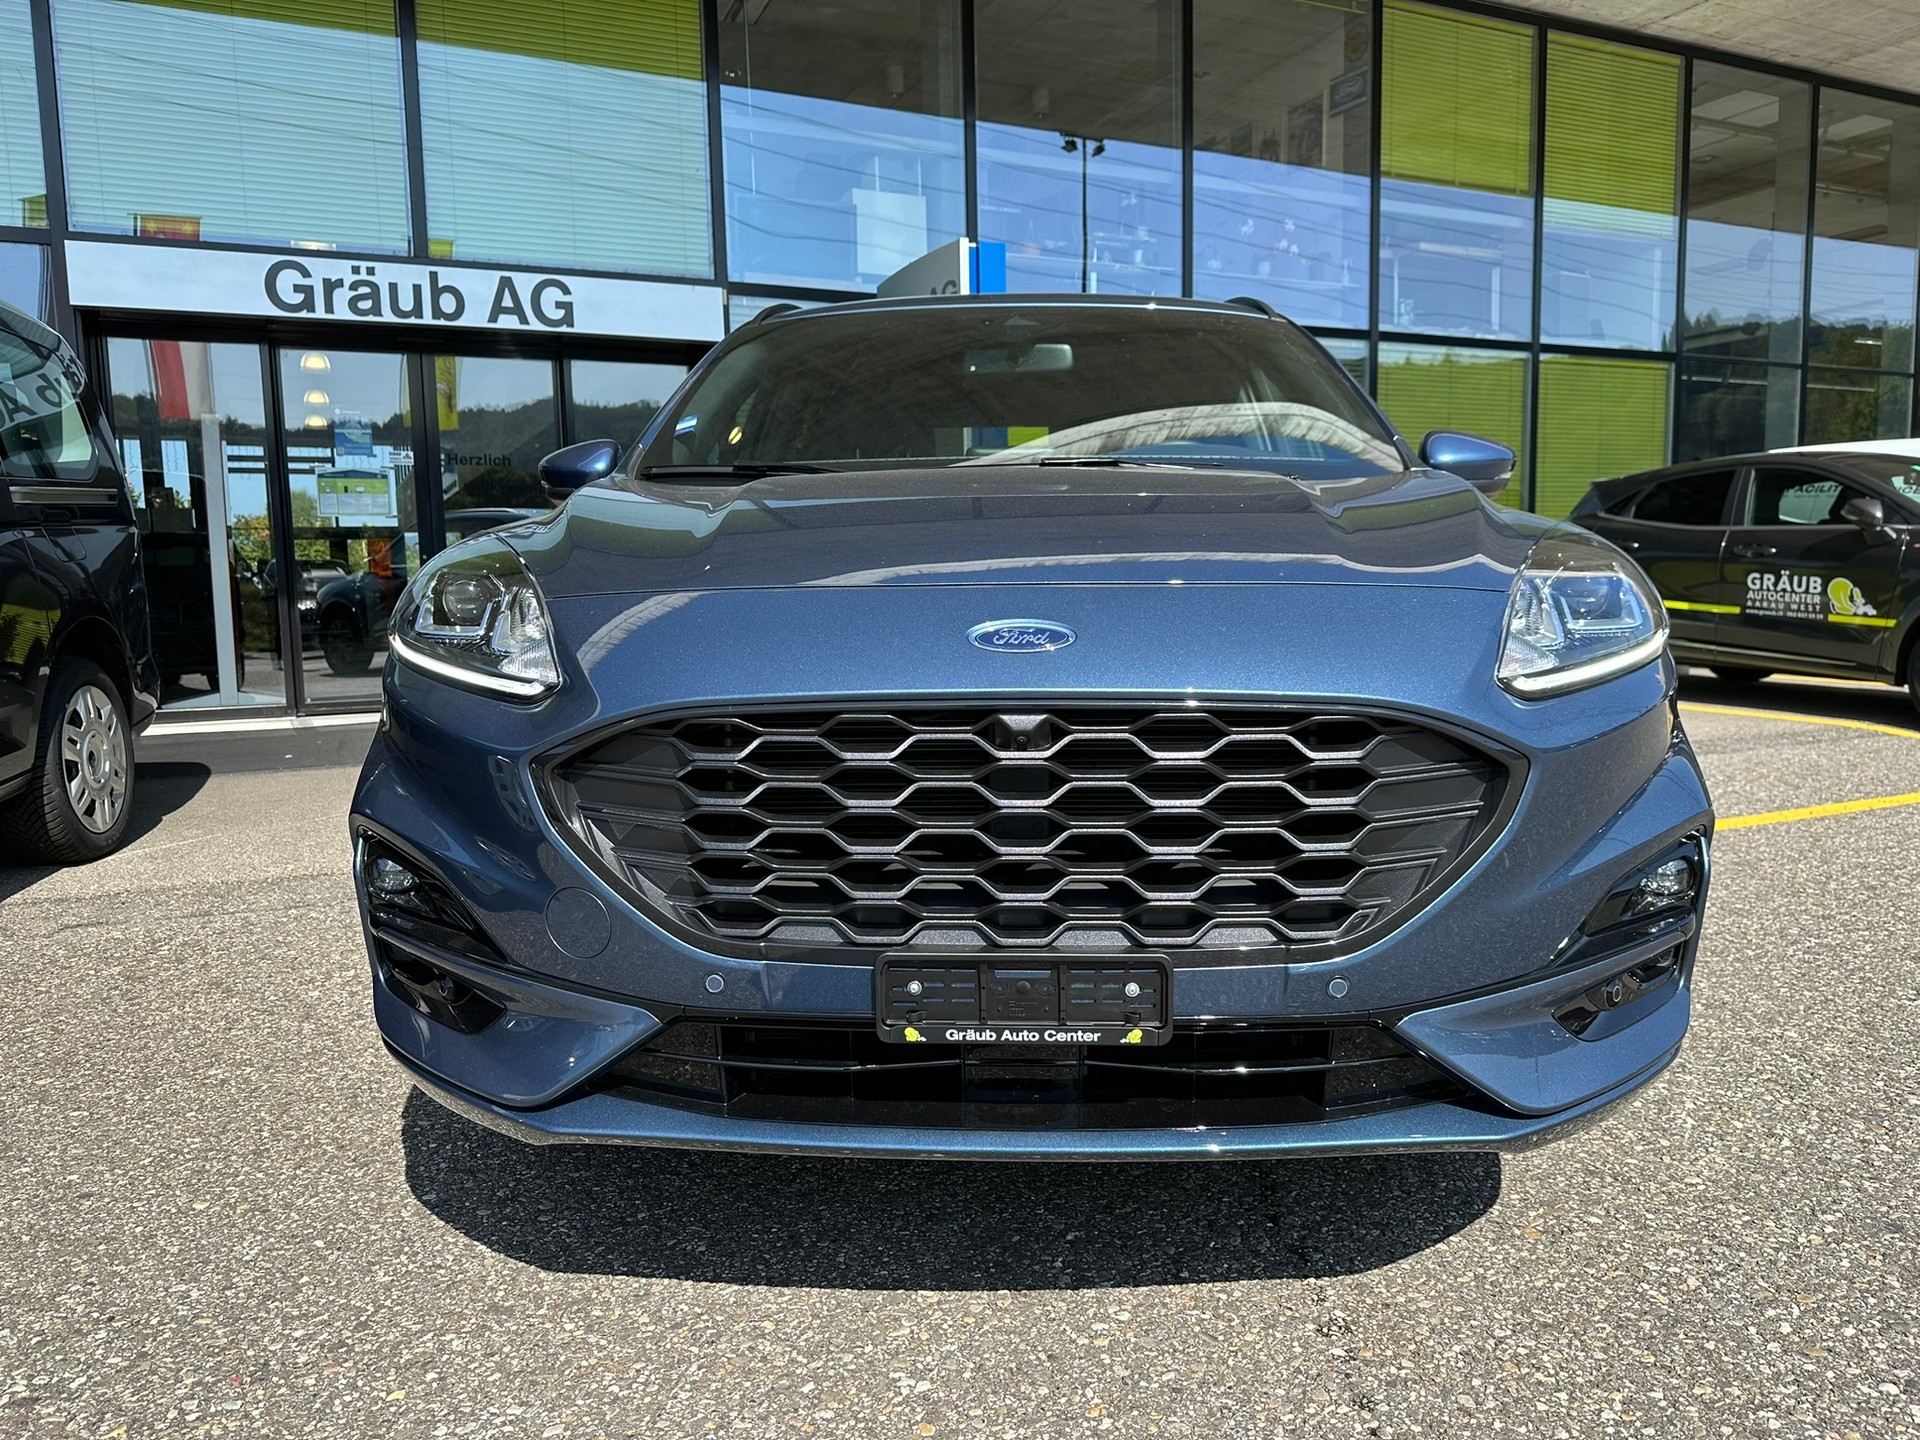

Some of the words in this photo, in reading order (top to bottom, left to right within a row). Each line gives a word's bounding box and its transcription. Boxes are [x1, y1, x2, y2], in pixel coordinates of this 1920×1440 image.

[264, 259, 466, 322] Gräub
[487, 275, 575, 328] AG
[447, 453, 512, 467] Herzlich
[1746, 569, 1822, 594] GRÄUB
[1746, 590, 1821, 604] AUTOCENTER
[1745, 599, 1785, 611] AARAU
[1790, 603, 1821, 613] WEST
[992, 628, 1051, 645] Ford
[945, 1028, 997, 1042] Gräub
[1000, 1029, 1039, 1042] Auto
[1043, 1030, 1102, 1043] Center
